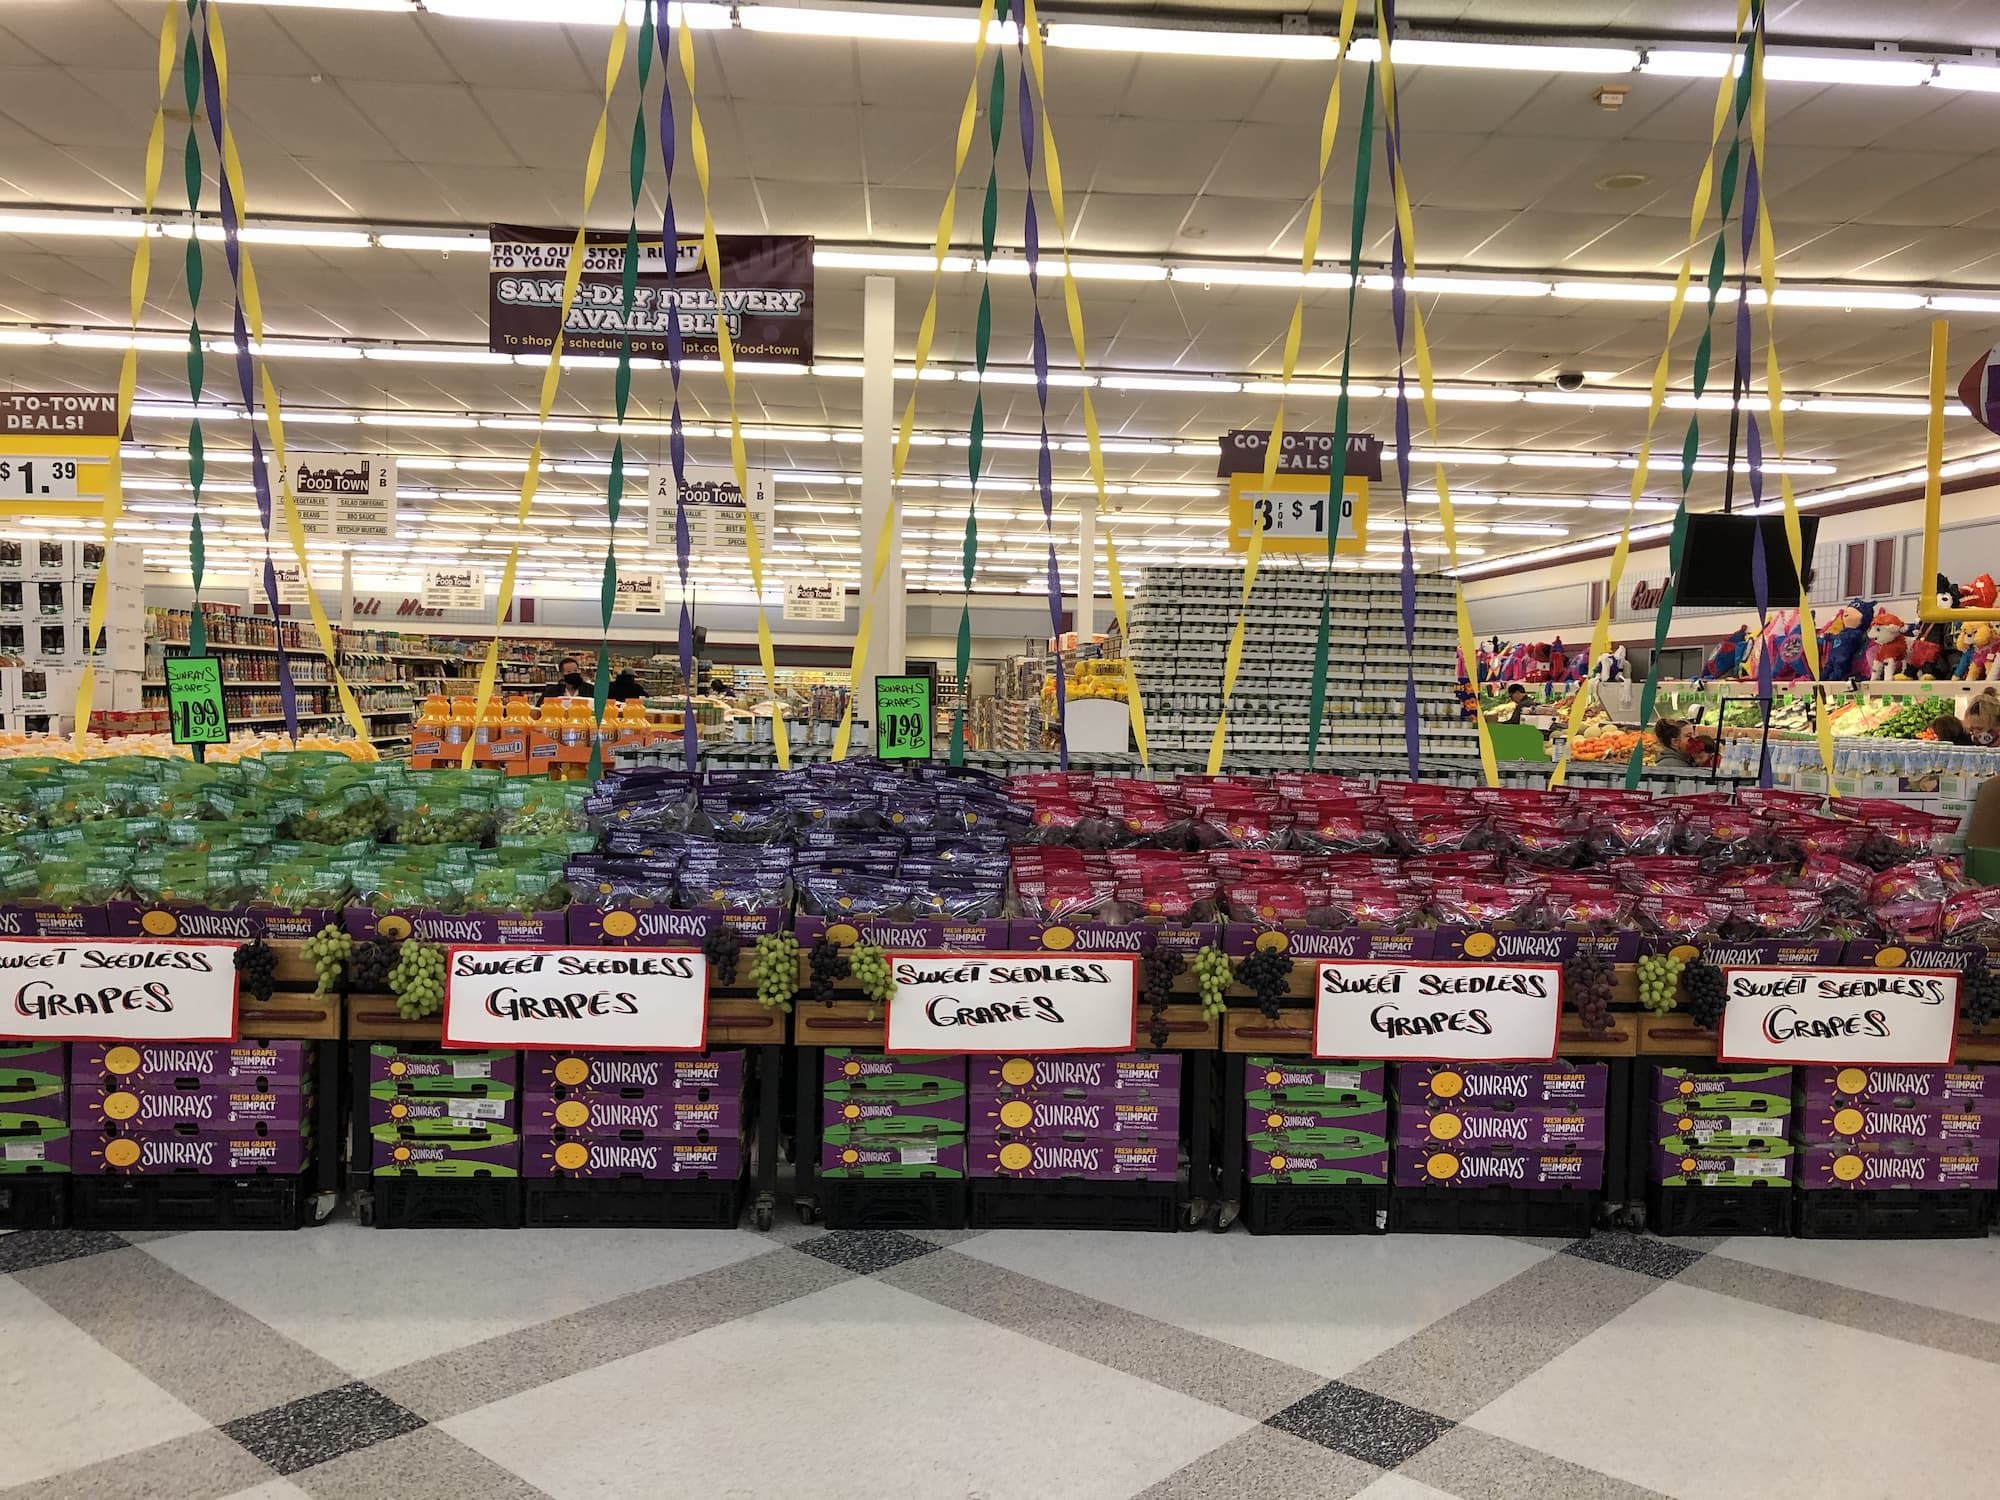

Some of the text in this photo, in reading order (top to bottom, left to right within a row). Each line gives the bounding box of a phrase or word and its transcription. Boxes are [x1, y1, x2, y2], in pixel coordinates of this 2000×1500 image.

[493, 245, 539, 256] FROM
[547, 247, 572, 257] OU
[647, 246, 697, 258] RIHT
[494, 257, 623, 270] TO YOUR OOR!
[661, 290, 802, 312] DELIVERY
[504, 335, 518, 344] To
[522, 335, 552, 347] shop
[570, 339, 622, 349] schedule
[632, 342, 647, 352] go
[651, 342, 664, 351] to
[0, 396, 115, 411] -TO-TOWN
[7, 415, 84, 430] DEALS!
[1234, 435, 1367, 452] GO-O-TON
[298, 474, 368, 490] FOOD TOWN
[380, 469, 387, 477] 2
[660, 478, 666, 486] 2
[380, 479, 387, 487] B
[658, 488, 667, 496] A
[757, 482, 762, 490] 1
[678, 487, 745, 503] FOOD TOWN
[756, 492, 764, 500] B
[1254, 499, 1273, 531] 3
[179, 914, 252, 938] SUNRAYS
[279, 925, 312, 933] IMPACT
[413, 919, 483, 941] SUNRAYS
[639, 914, 707, 938] SUNRAYS
[861, 927, 928, 948] SUNRAYS
[956, 934, 986, 942] IMPACT
[1075, 929, 1142, 950] SUNRAYS
[1170, 937, 1200, 945] IMPACT
[1289, 935, 1356, 956] SUNRAYS
[1383, 943, 1412, 951] IMPACT
[1496, 935, 1562, 957] SUNRAYS
[80, 950, 213, 972] SEEDLESS
[454, 952, 693, 979] SWEET SEEDLESS
[1701, 948, 1766, 964] SUNRAYS
[1906, 950, 1973, 968] SUNRAYS
[896, 961, 1111, 985] SWEET SEEDLESS
[1323, 968, 1547, 998] SWEET SEEDLESS
[1733, 973, 1944, 1005] SWEET SEEDLESS
[14, 980, 174, 1020] GRAPES
[485, 987, 638, 1021] GRAPES
[926, 995, 1064, 1027] GRAPES
[1371, 1003, 1493, 1039] GRAPES
[1763, 1004, 1890, 1043] GRAPES
[142, 1049, 213, 1074] SUNRAYS
[244, 1057, 276, 1066] IMPACT
[252, 1049, 277, 1057] GRAPES
[407, 1064, 440, 1076] SUNRAYS
[590, 1061, 658, 1086] SUNRAYS
[687, 1069, 718, 1078] IMPACT
[861, 1063, 893, 1074] SUNRAYS
[1035, 1061, 1101, 1086] SUNRAYS
[1128, 1070, 1159, 1079] IMPACT
[1136, 1062, 1160, 1070] GRAPES
[1464, 1074, 1528, 1098] SUNRAYS
[1555, 1081, 1585, 1090] IMPACT
[1868, 1072, 1930, 1096] SUNRAYS
[1945, 1073, 1961, 1081] FRESH
[1956, 1081, 1984, 1090] IMPACT
[141, 1095, 212, 1119] SUNRAYS
[407, 1105, 441, 1117] SUNRAYS
[591, 1104, 658, 1128] SUNRAYS
[1034, 1104, 1100, 1128] SUNRAYS
[1283, 1116, 1315, 1127] SUNRAYS
[1463, 1116, 1528, 1141] SUNRAYS
[1865, 1112, 1927, 1136] SUNRAYS
[142, 1141, 212, 1165] SUNRAYS
[590, 1146, 657, 1170] SUNRAYS
[858, 1151, 890, 1163] SUNRAYS
[1033, 1147, 1098, 1171] SUNRAYS
[1460, 1157, 1525, 1180] SUNRAYS
[1696, 1160, 1727, 1171] SUNRAYS
[1865, 1158, 1925, 1180] SUNRAYS
